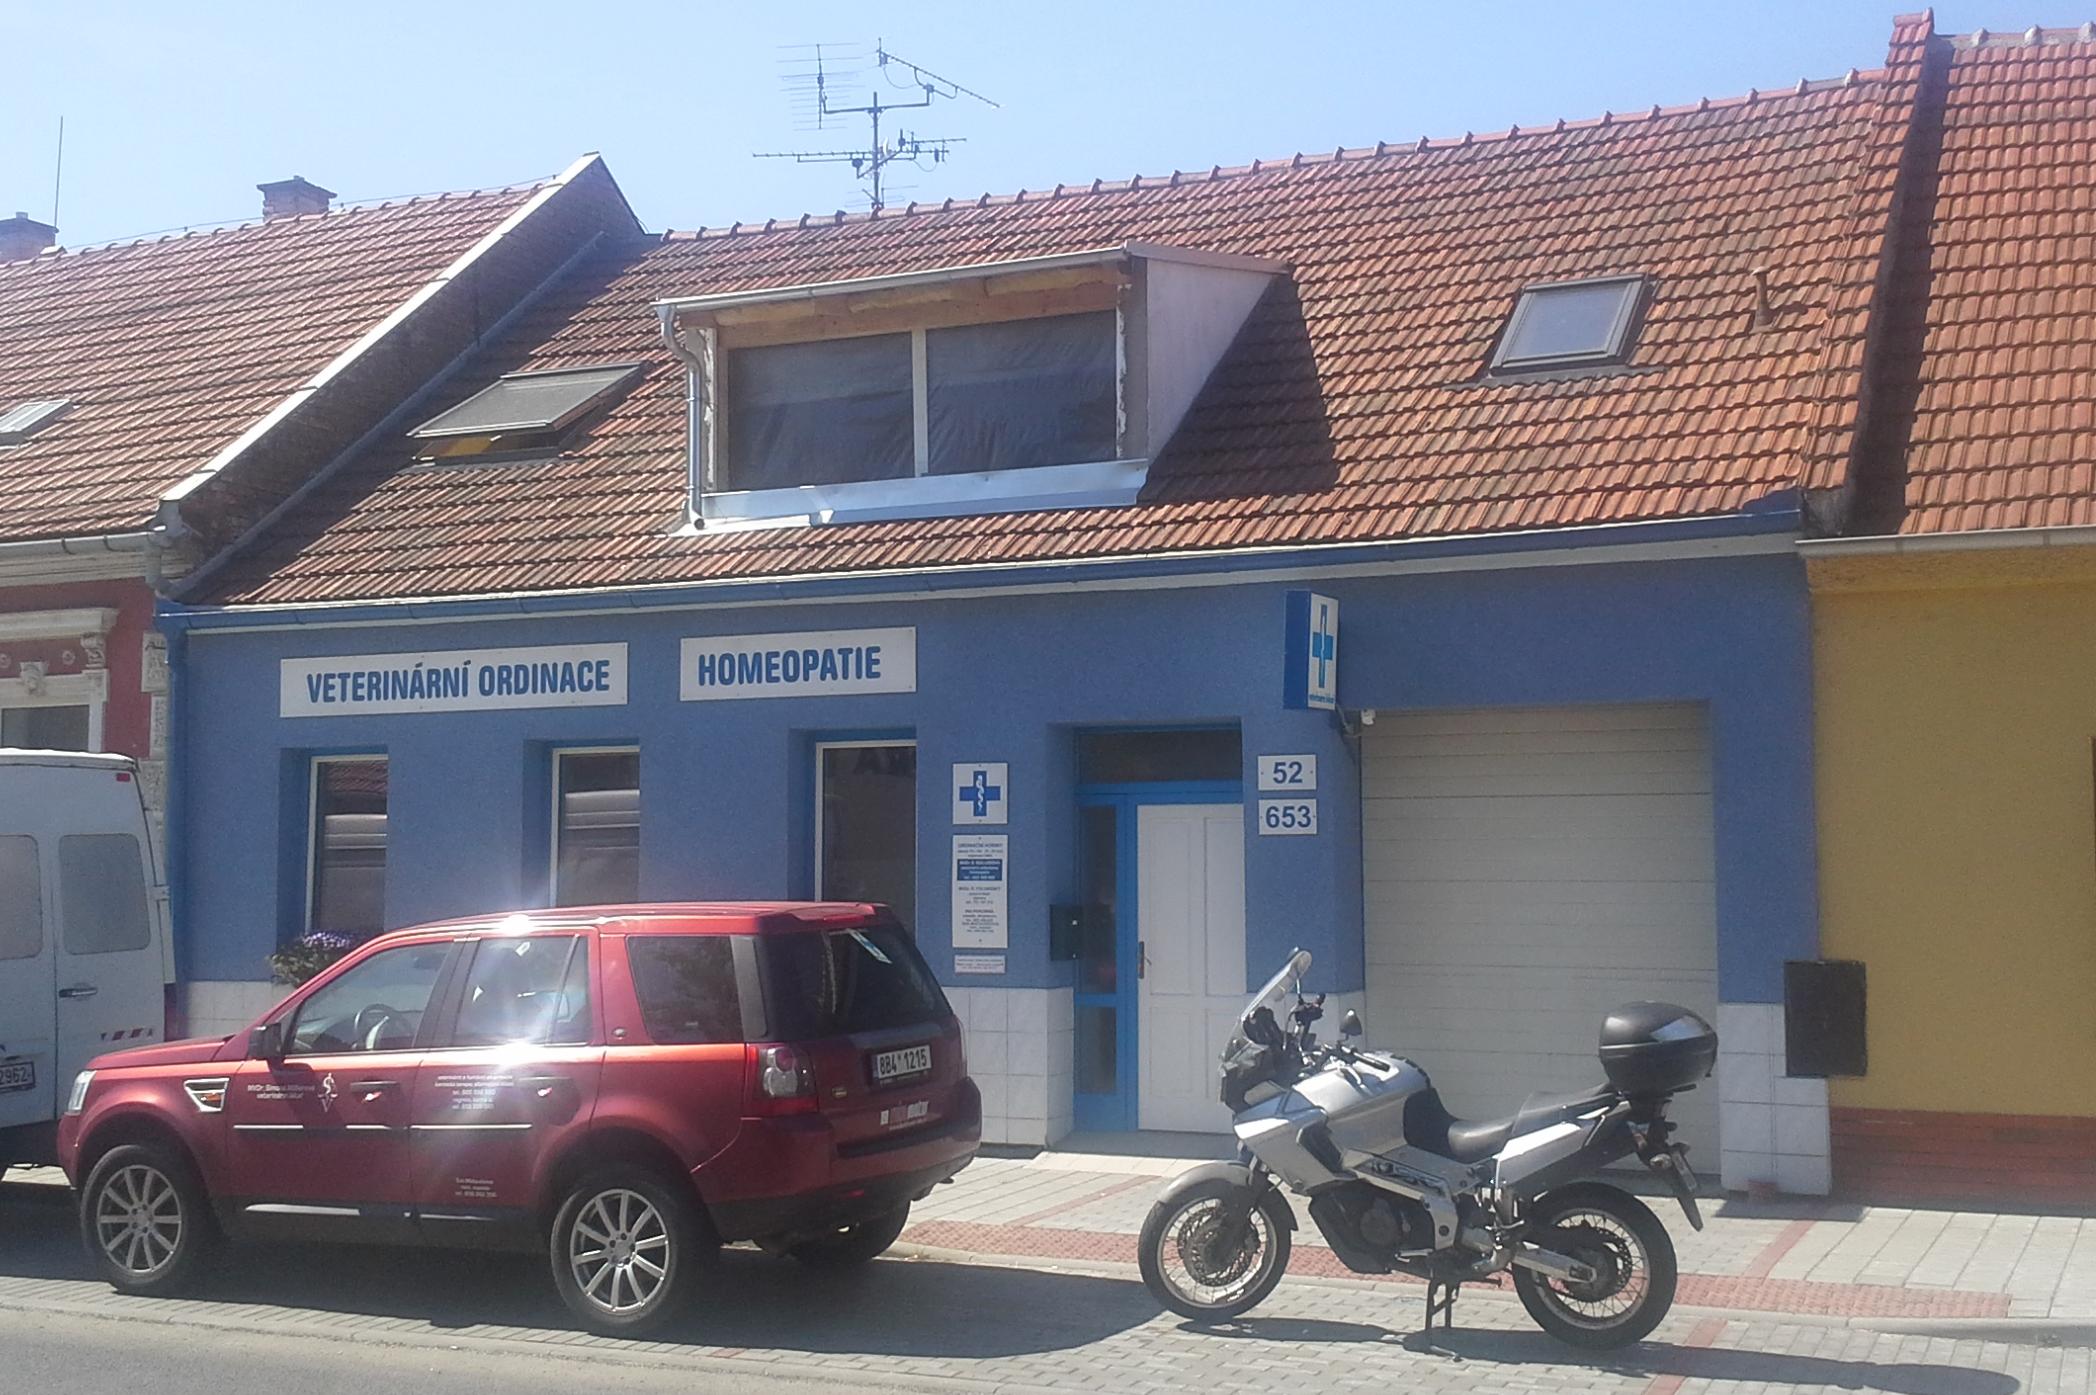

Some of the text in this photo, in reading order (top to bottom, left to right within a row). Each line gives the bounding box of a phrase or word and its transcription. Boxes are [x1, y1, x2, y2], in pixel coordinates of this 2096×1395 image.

[698, 646, 882, 686] HOMEOPATIE
[307, 659, 610, 703] VETERINÁRNÍ ORDINACE
[1273, 761, 1303, 784] 52
[1265, 805, 1312, 828] 653
[880, 1048, 927, 1075] 8B4 1215
